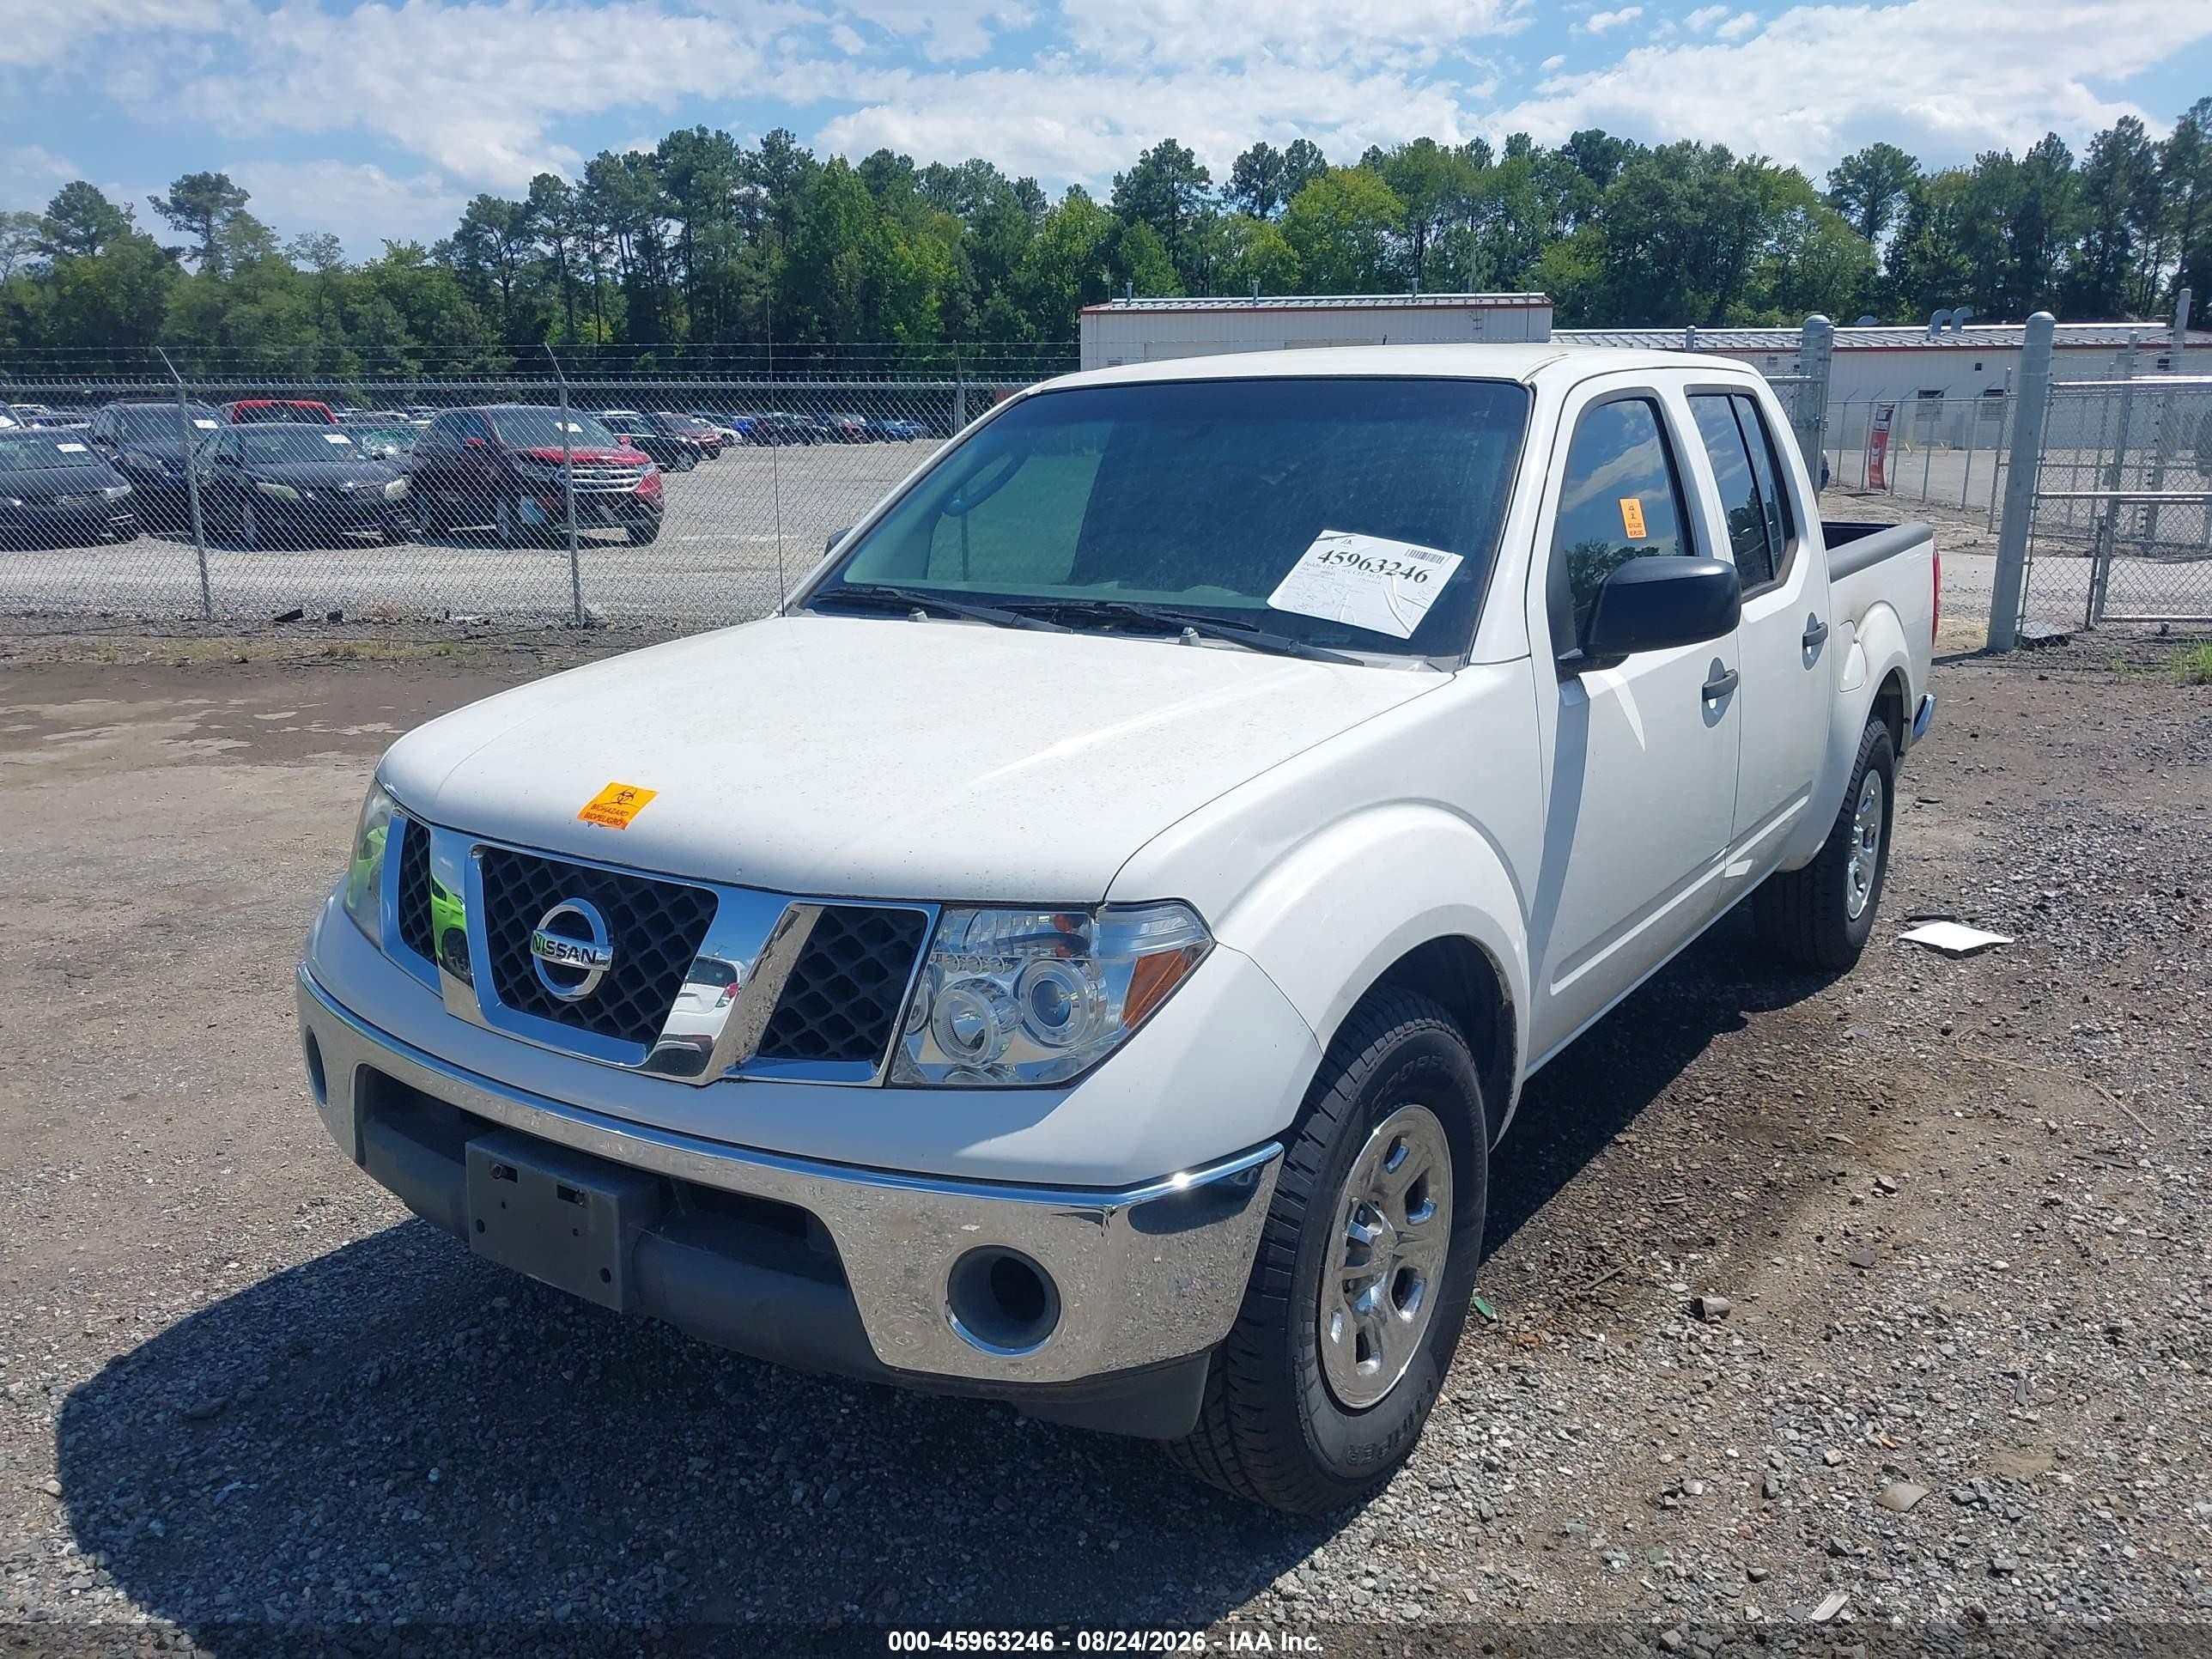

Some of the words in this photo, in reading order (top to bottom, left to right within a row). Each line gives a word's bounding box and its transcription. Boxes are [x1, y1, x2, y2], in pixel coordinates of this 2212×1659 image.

[1317, 550, 1436, 584] 45963246
[583, 811, 623, 826] BIOPELIGRO
[590, 803, 629, 817] BIOHAZARD
[532, 933, 598, 964] NISSAN
